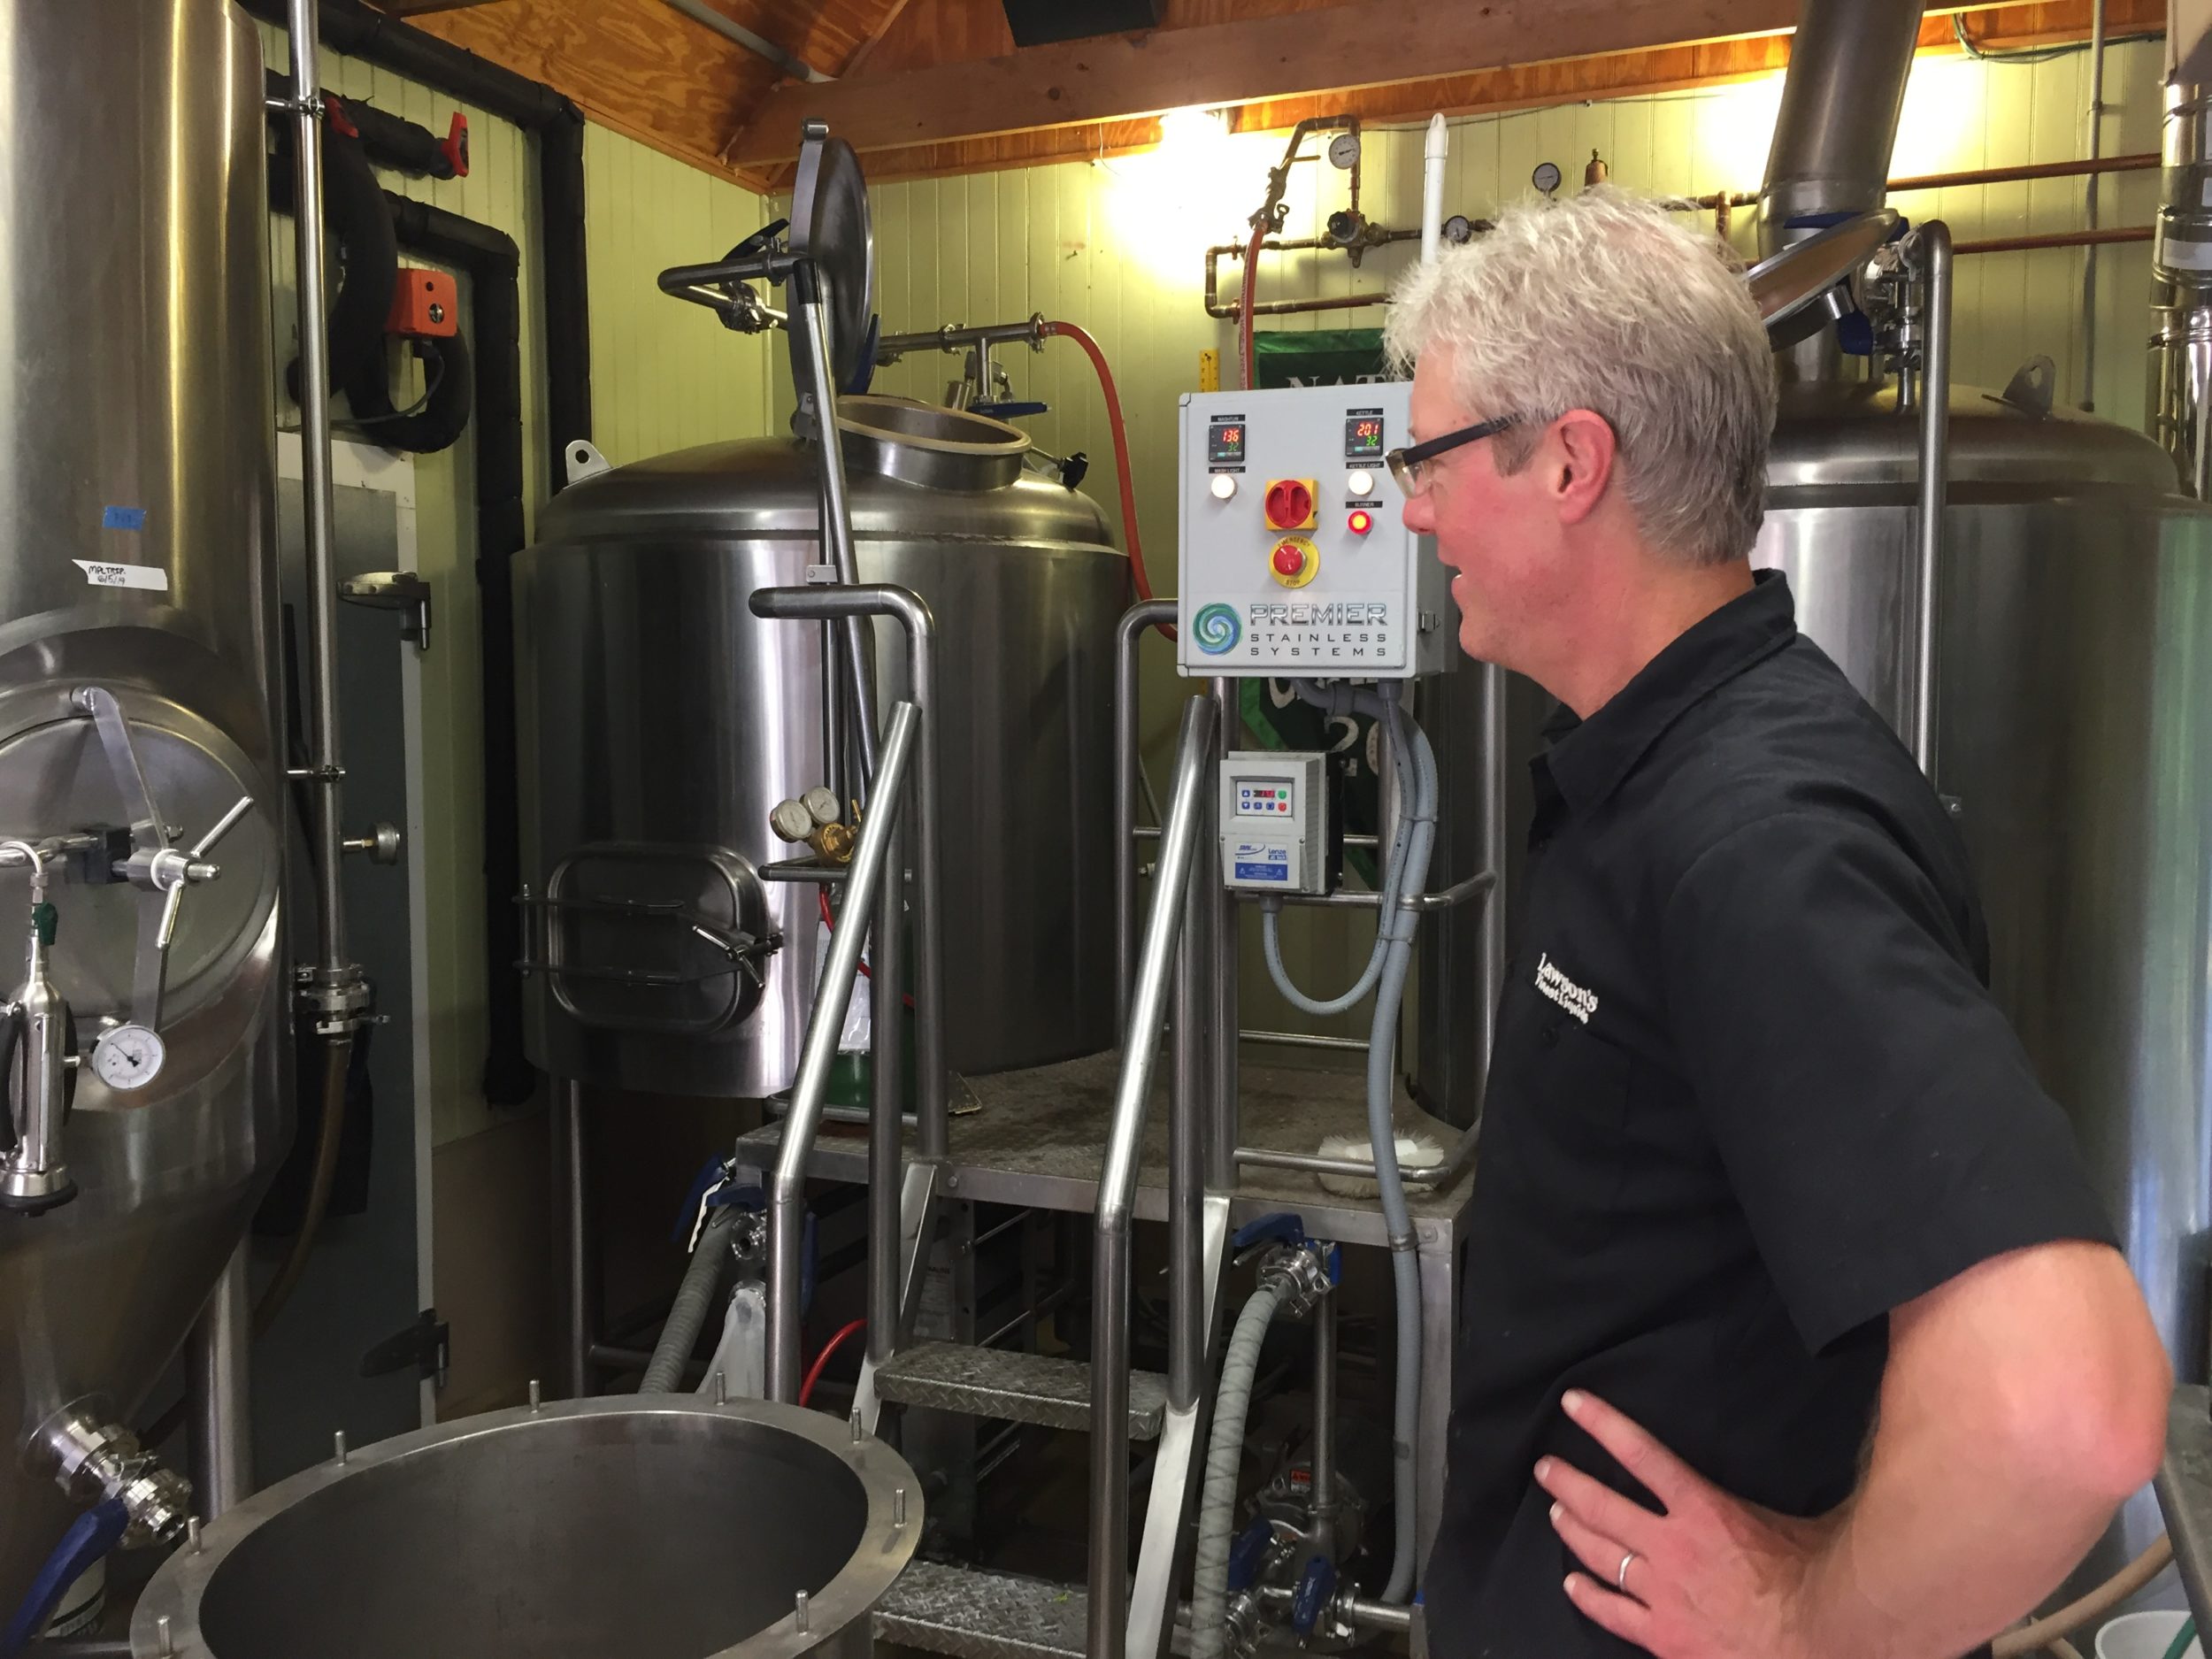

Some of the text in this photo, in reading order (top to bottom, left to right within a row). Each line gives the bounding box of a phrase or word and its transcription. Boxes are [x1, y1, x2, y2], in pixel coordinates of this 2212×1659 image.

[1223, 429, 1240, 442] 136
[1357, 424, 1379, 436] 201
[1366, 435, 1378, 446] 32
[1228, 442, 1240, 452] 32
[1278, 535, 1311, 548] EMERGENCY
[1249, 603, 1388, 626] PREMIER
[1249, 634, 1386, 642] STAINLESS
[1249, 648, 1386, 657] SYSTEMS
[1537, 952, 1599, 1012] Lawson's
